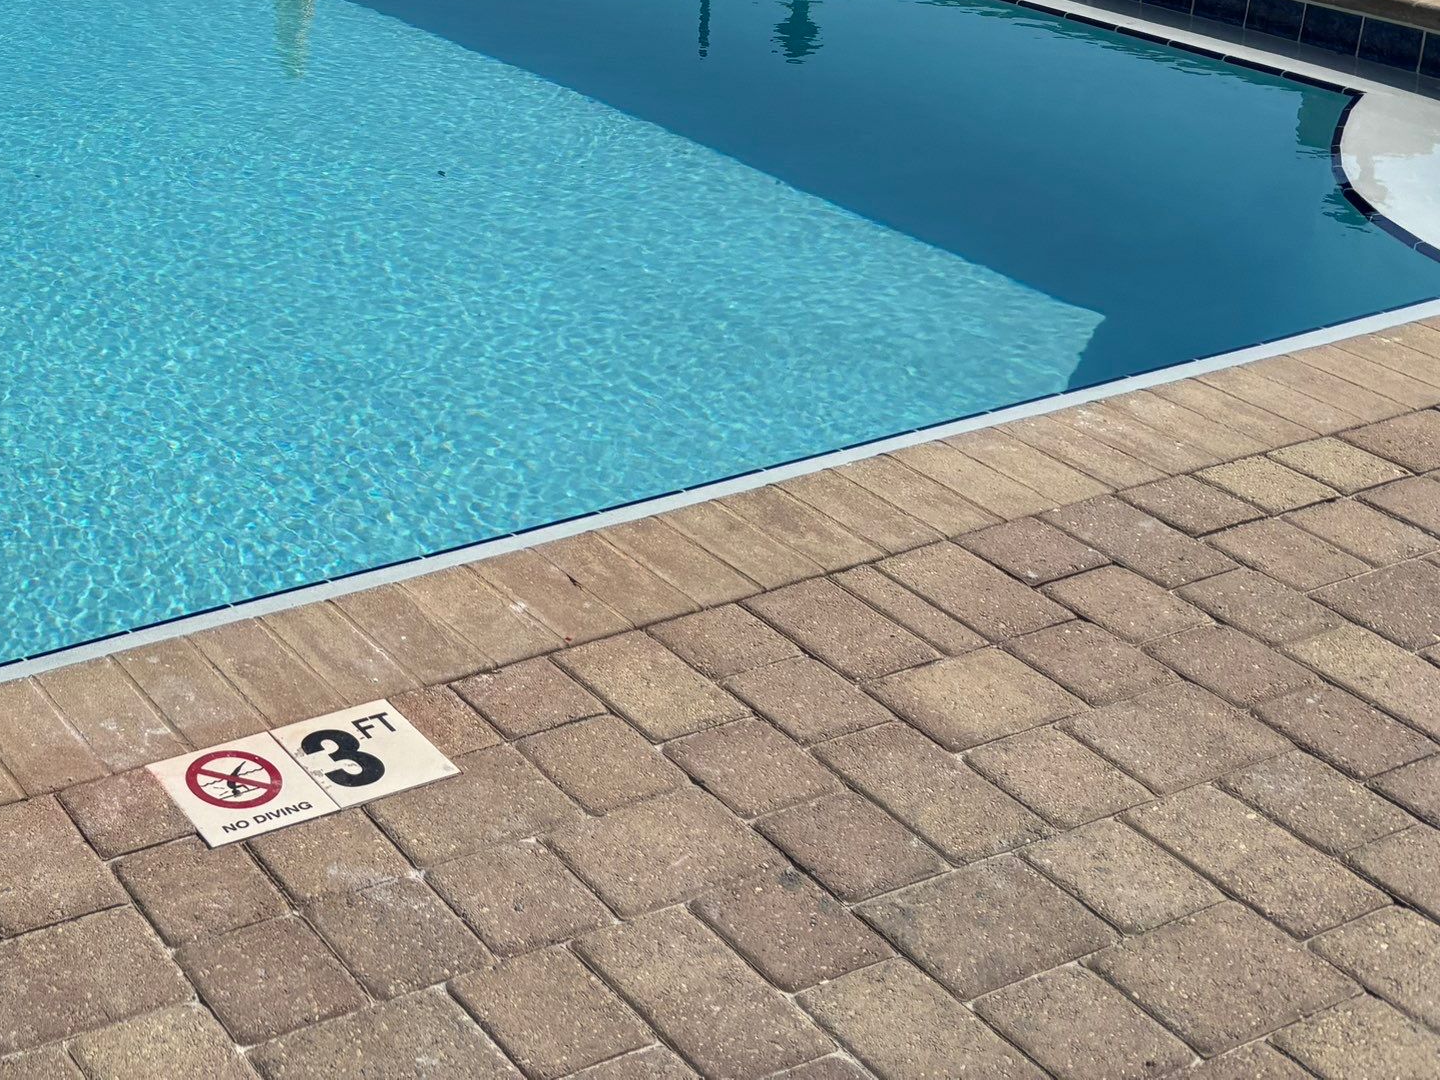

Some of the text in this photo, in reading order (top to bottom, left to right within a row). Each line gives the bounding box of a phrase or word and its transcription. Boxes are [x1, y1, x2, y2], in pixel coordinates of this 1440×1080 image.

[300, 712, 396, 788] 3 FT
[222, 801, 313, 833] NO DIVING
